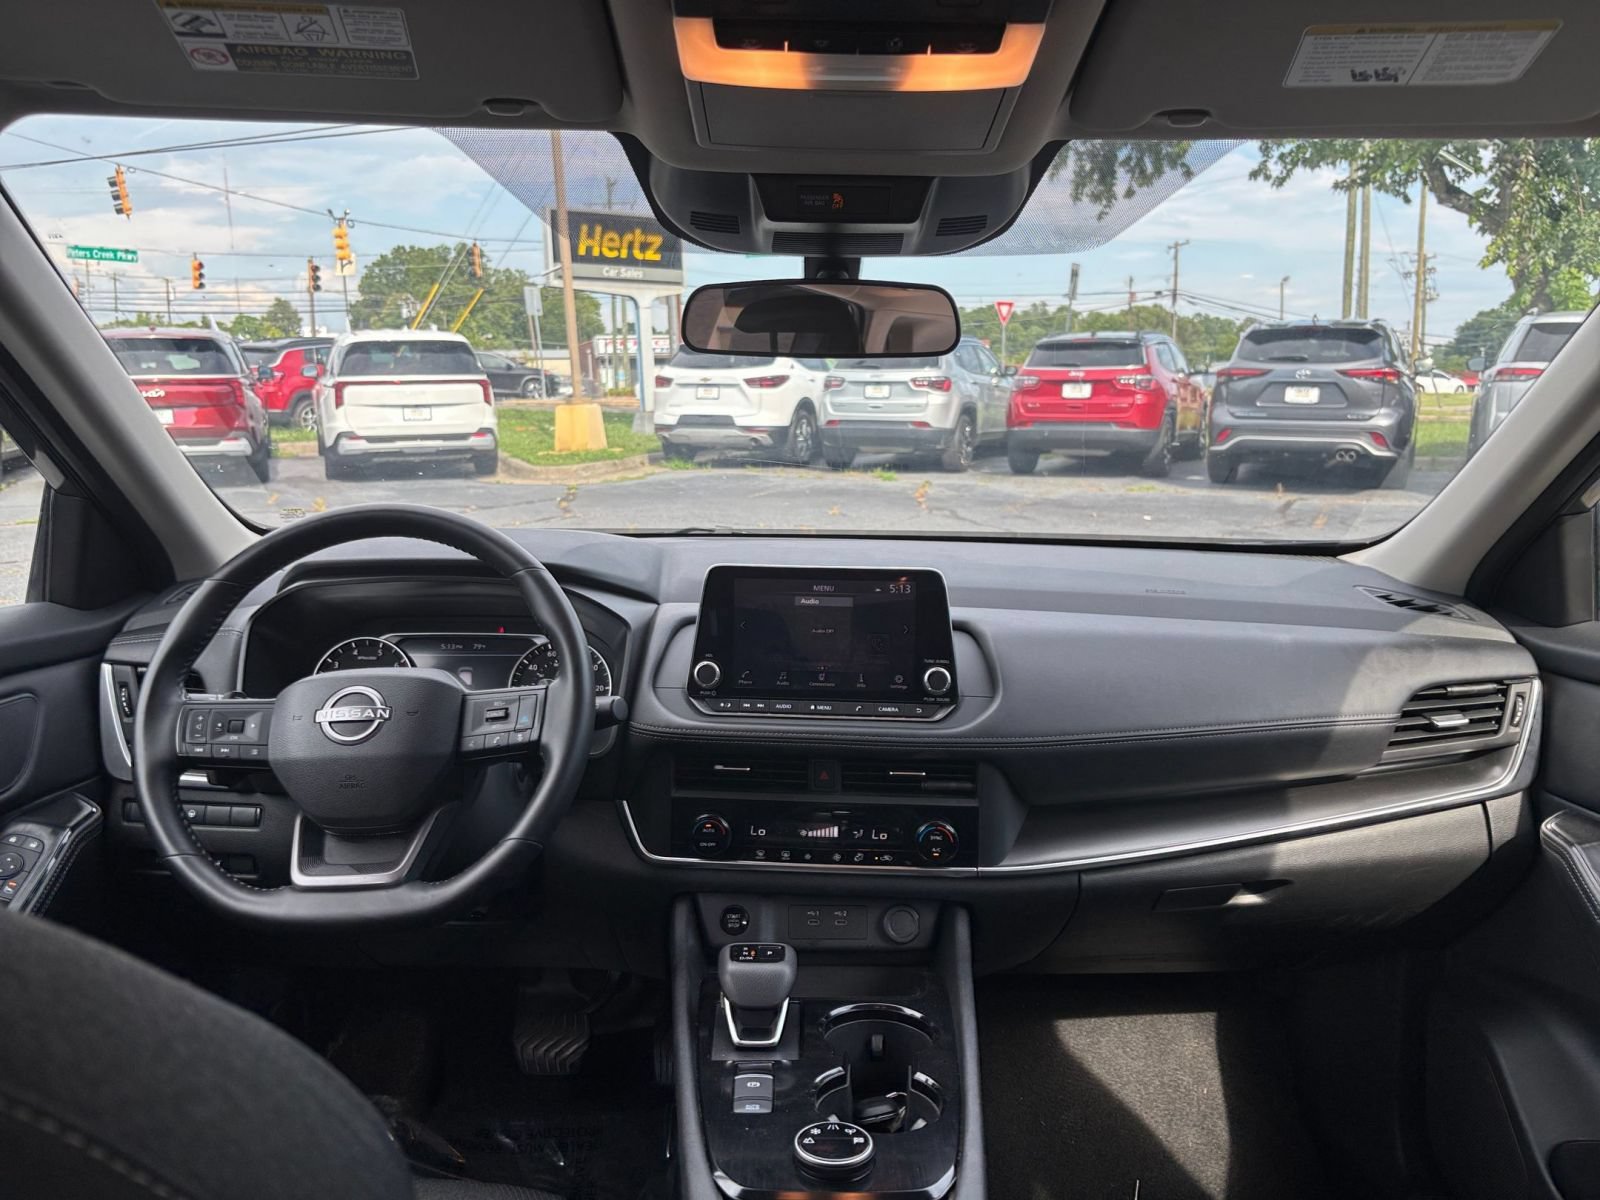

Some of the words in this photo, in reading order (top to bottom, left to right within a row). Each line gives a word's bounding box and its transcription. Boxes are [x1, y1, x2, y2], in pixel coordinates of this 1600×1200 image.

[236, 44, 309, 56] AIRBAG
[317, 48, 407, 60] WARNING
[577, 223, 664, 261] Hertz
[92, 249, 115, 259] Creek
[602, 266, 618, 277] Car
[619, 267, 643, 279] Sales
[813, 584, 835, 592] MENU
[889, 584, 912, 594] 5:13
[800, 597, 820, 605] Audio
[547, 650, 557, 658] 60
[333, 661, 339, 669] 3
[527, 663, 538, 671] 40
[317, 708, 390, 720] NISSAN
[750, 825, 766, 836] Lo
[871, 829, 888, 841] Lo
